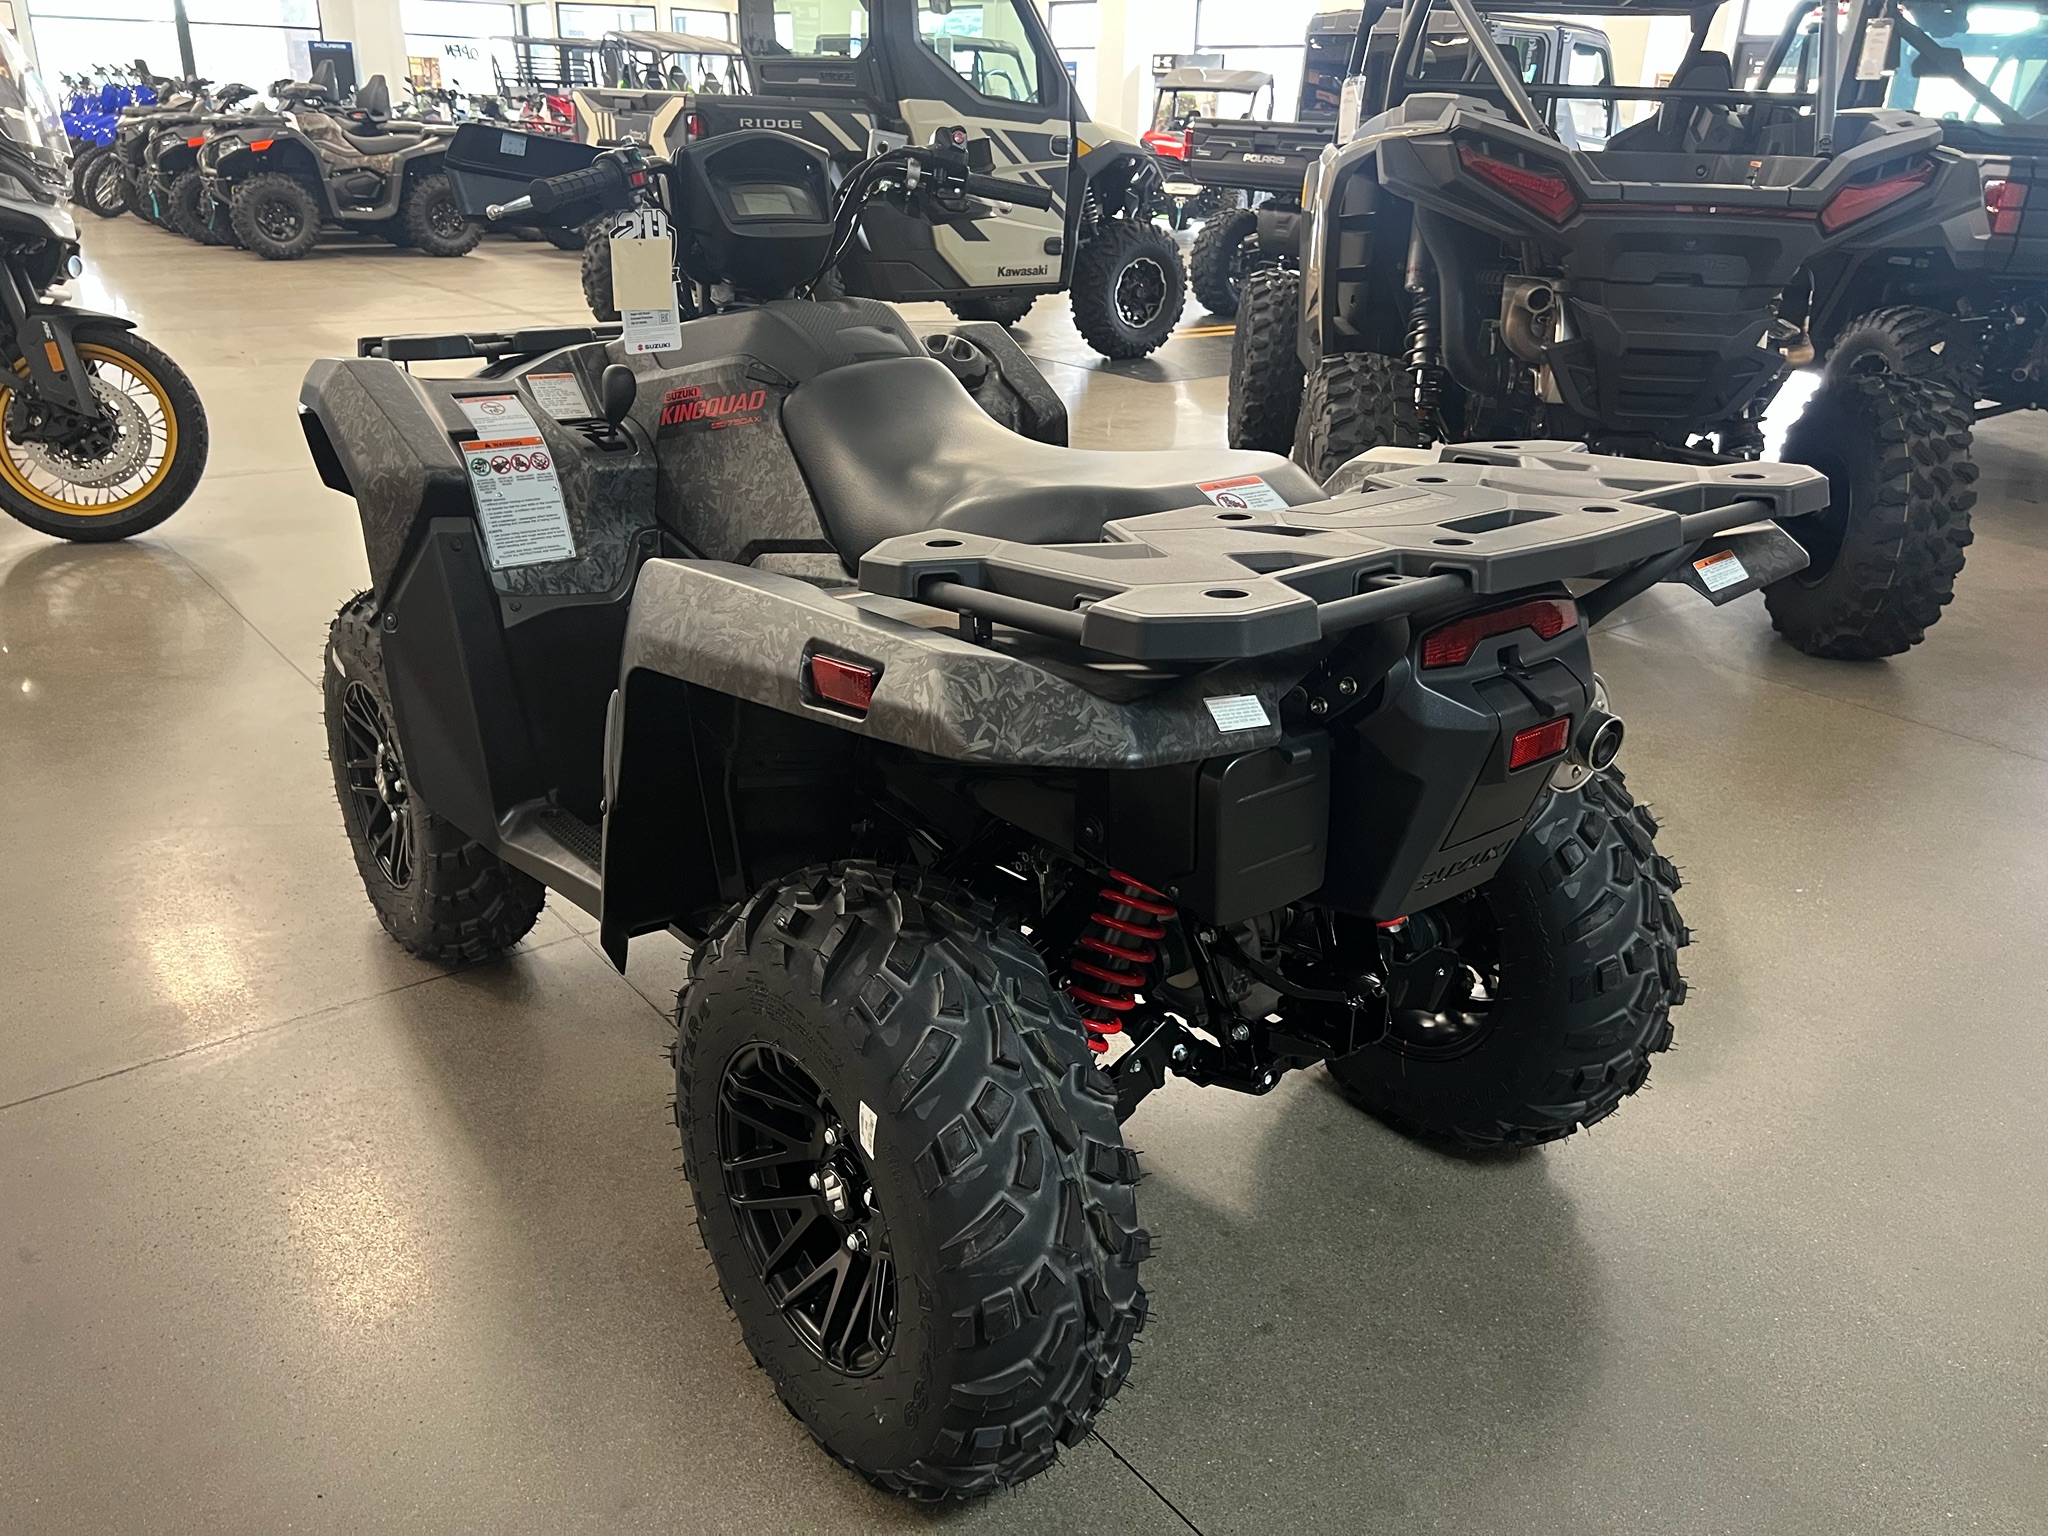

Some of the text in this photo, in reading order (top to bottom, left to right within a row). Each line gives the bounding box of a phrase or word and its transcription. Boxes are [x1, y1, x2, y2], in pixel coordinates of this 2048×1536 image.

[740, 118, 803, 129] RIDGE
[1242, 153, 1286, 165] POLARIS
[997, 264, 1049, 278] Kawasaki
[644, 342, 671, 350] SUZUKI
[666, 387, 698, 401] SUZUKI
[661, 389, 766, 426] KINGQUAD
[1413, 837, 1515, 892] SUZUKI
